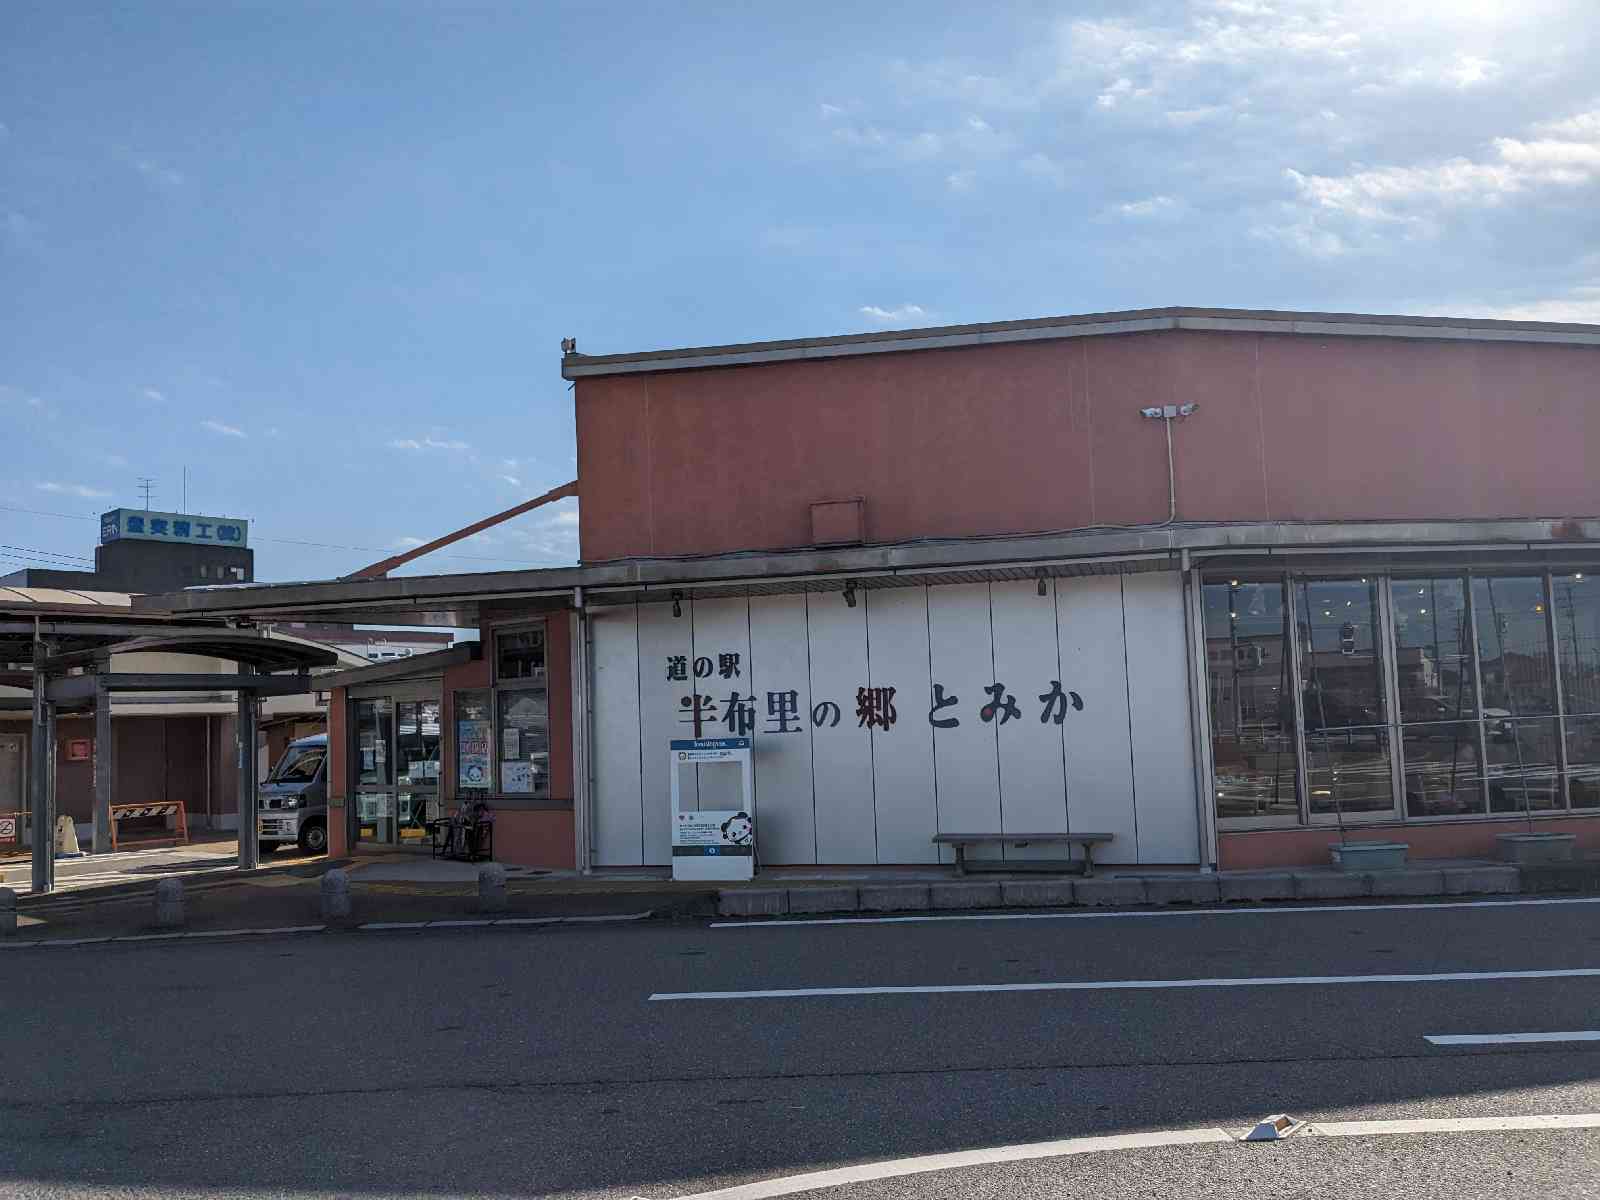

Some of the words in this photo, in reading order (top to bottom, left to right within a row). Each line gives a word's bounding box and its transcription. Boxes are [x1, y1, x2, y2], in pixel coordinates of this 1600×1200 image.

[666, 653, 741, 681] 道の駅
[678, 686, 897, 738] 半布里の郷
[929, 681, 1084, 728] とみか
